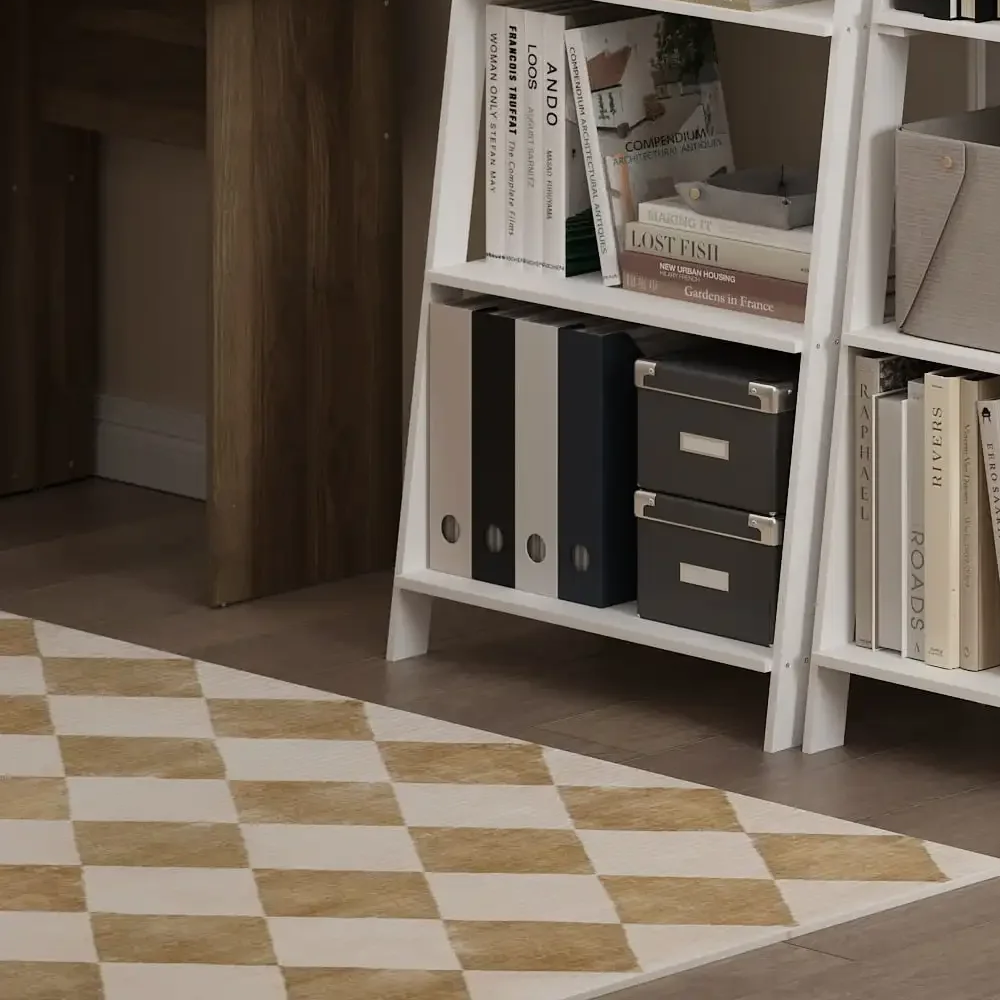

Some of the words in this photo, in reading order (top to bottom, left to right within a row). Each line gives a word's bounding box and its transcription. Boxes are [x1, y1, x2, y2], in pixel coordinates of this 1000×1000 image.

[489, 33, 498, 80] WOMAN
[508, 25, 517, 82] FRANCOIS
[527, 44, 537, 90] LOOS
[489, 83, 498, 119] ONLY
[546, 62, 558, 127] ANDO
[508, 140, 516, 158] The
[569, 46, 585, 115] COMPENDIUM
[579, 118, 598, 199] ARCHITECTURAL
[594, 202, 608, 254] ANTIQUES
[625, 127, 707, 153] COMPENDIUM
[507, 161, 516, 208] Complete
[507, 211, 515, 236] Films
[648, 209, 697, 229] MAKING
[699, 219, 712, 231] IT
[632, 229, 676, 254] LOST
[680, 239, 719, 263] FISH
[660, 262, 676, 272] NEW
[677, 265, 701, 277] URBAN
[703, 269, 736, 284] HOUSING
[684, 285, 725, 305] Gardens
[728, 294, 737, 306] in
[740, 295, 775, 313] France
[860, 383, 870, 522] RAPHAEL
[932, 406, 943, 488] RIVERS
[986, 443, 998, 482] EERO
[910, 530, 925, 631] ROADS
